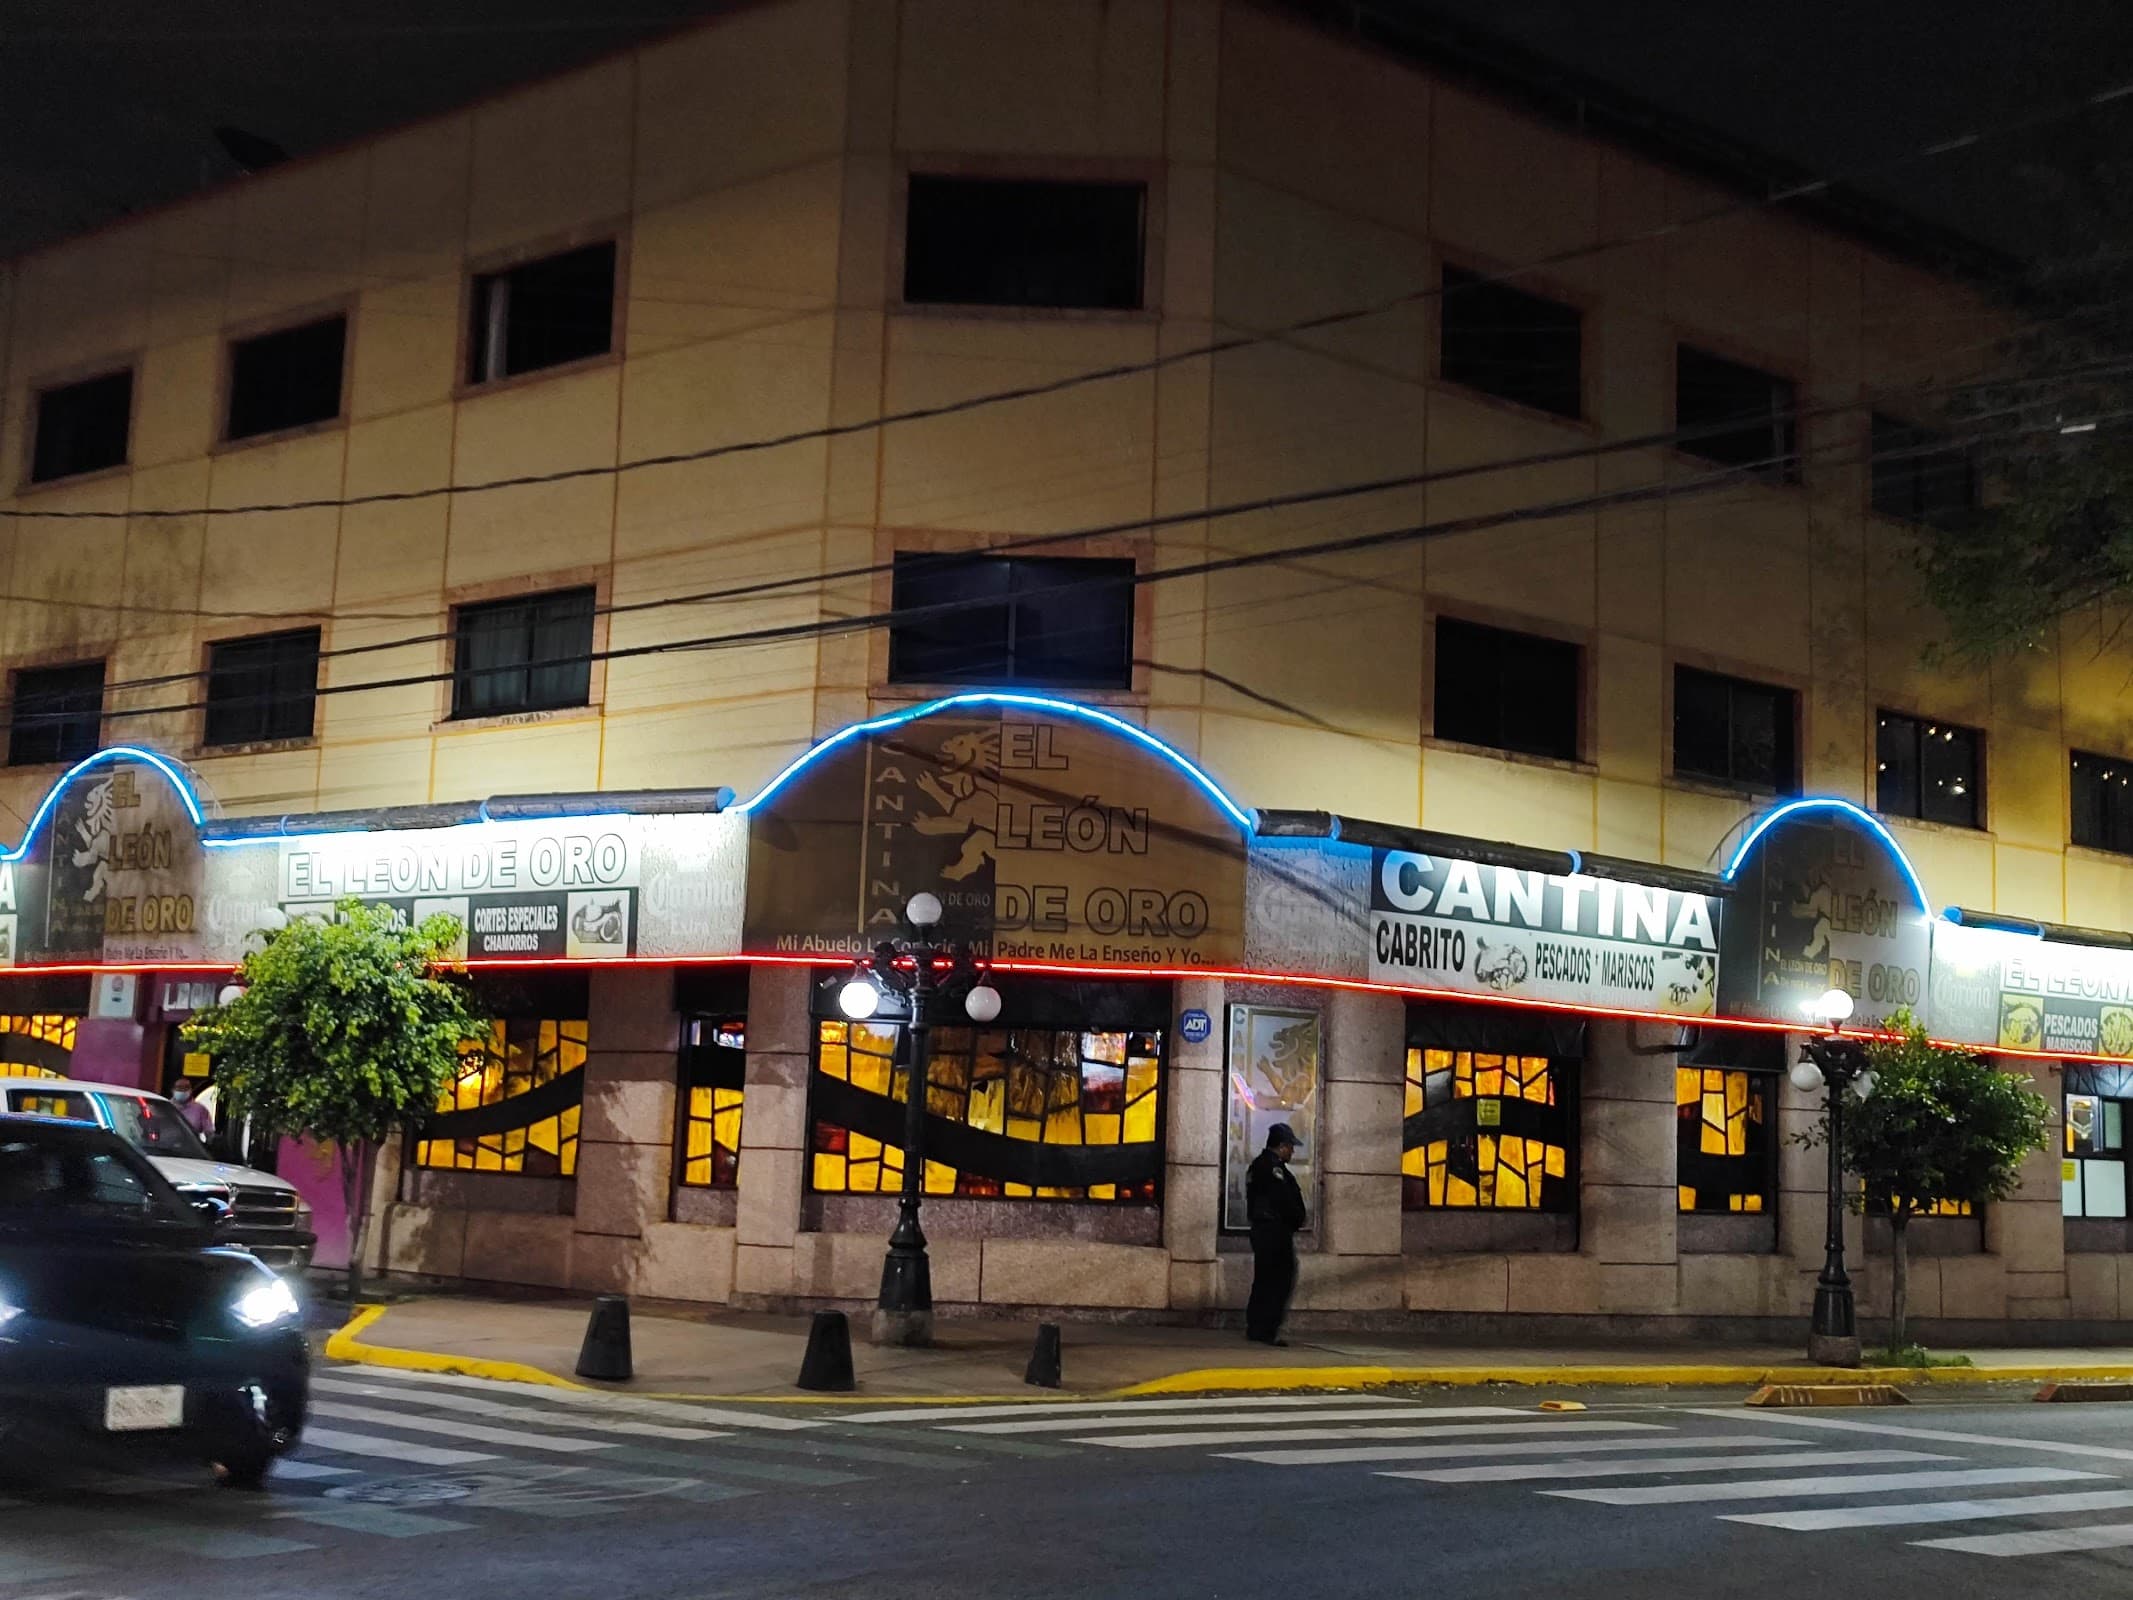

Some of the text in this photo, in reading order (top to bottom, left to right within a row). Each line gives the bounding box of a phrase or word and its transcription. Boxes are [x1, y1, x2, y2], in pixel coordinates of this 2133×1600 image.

[999, 723, 1068, 771] EL
[112, 769, 140, 808] EL
[108, 822, 172, 871] LEÓN
[868, 738, 906, 925] CANTINA
[995, 797, 1149, 855] LEÓN
[287, 851, 333, 898] EL
[461, 839, 518, 890] DE
[529, 833, 628, 887] ORO
[1834, 832, 1865, 872] EL
[104, 896, 138, 934] DE
[142, 893, 195, 934] ORO
[474, 905, 559, 934] CORTES ESPECIALES
[995, 883, 1069, 934] DE
[1084, 887, 1209, 939] ORO
[1381, 850, 1717, 950] CANTINA
[1830, 887, 1898, 938] LEÓN
[483, 933, 539, 952] CHAMORROS
[776, 934, 798, 952] Mi
[801, 934, 862, 954] Abuelo
[967, 939, 989, 957] Mi
[997, 941, 1045, 959] Padre
[1049, 942, 1075, 960] Me
[1080, 943, 1098, 961] La
[1103, 944, 1162, 964] Enseño
[1167, 946, 1177, 963] Y
[1181, 947, 1216, 967] Yo...
[1375, 919, 1466, 973] CABRITO
[1534, 941, 1592, 985] PESCADOS
[1601, 949, 1656, 992] MARISCOS
[1828, 957, 1921, 1007] DE ORO
[2003, 952, 2040, 992] EL
[1184, 1018, 1207, 1032] ADT
[2044, 1013, 2098, 1038] PESCADOS
[2046, 1036, 2093, 1053] MARISCOS
